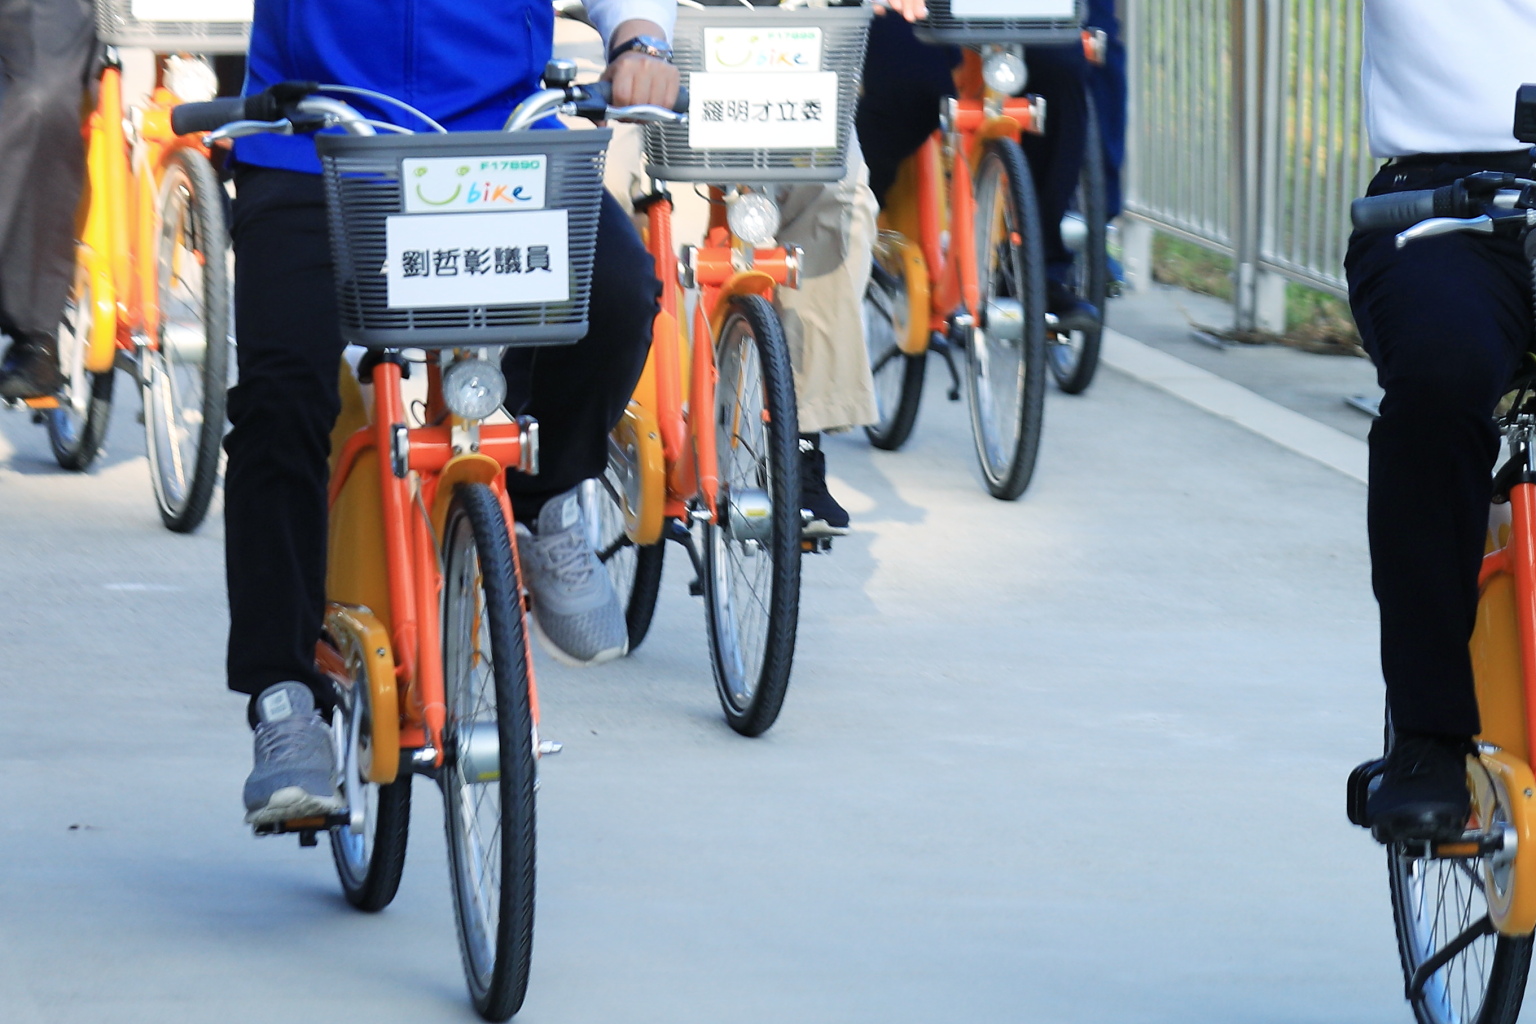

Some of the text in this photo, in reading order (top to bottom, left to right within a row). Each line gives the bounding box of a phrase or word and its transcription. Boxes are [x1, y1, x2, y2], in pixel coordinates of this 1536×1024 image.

[702, 99, 822, 122] 羅明才立委
[402, 245, 552, 277] 劉哲彰議員
